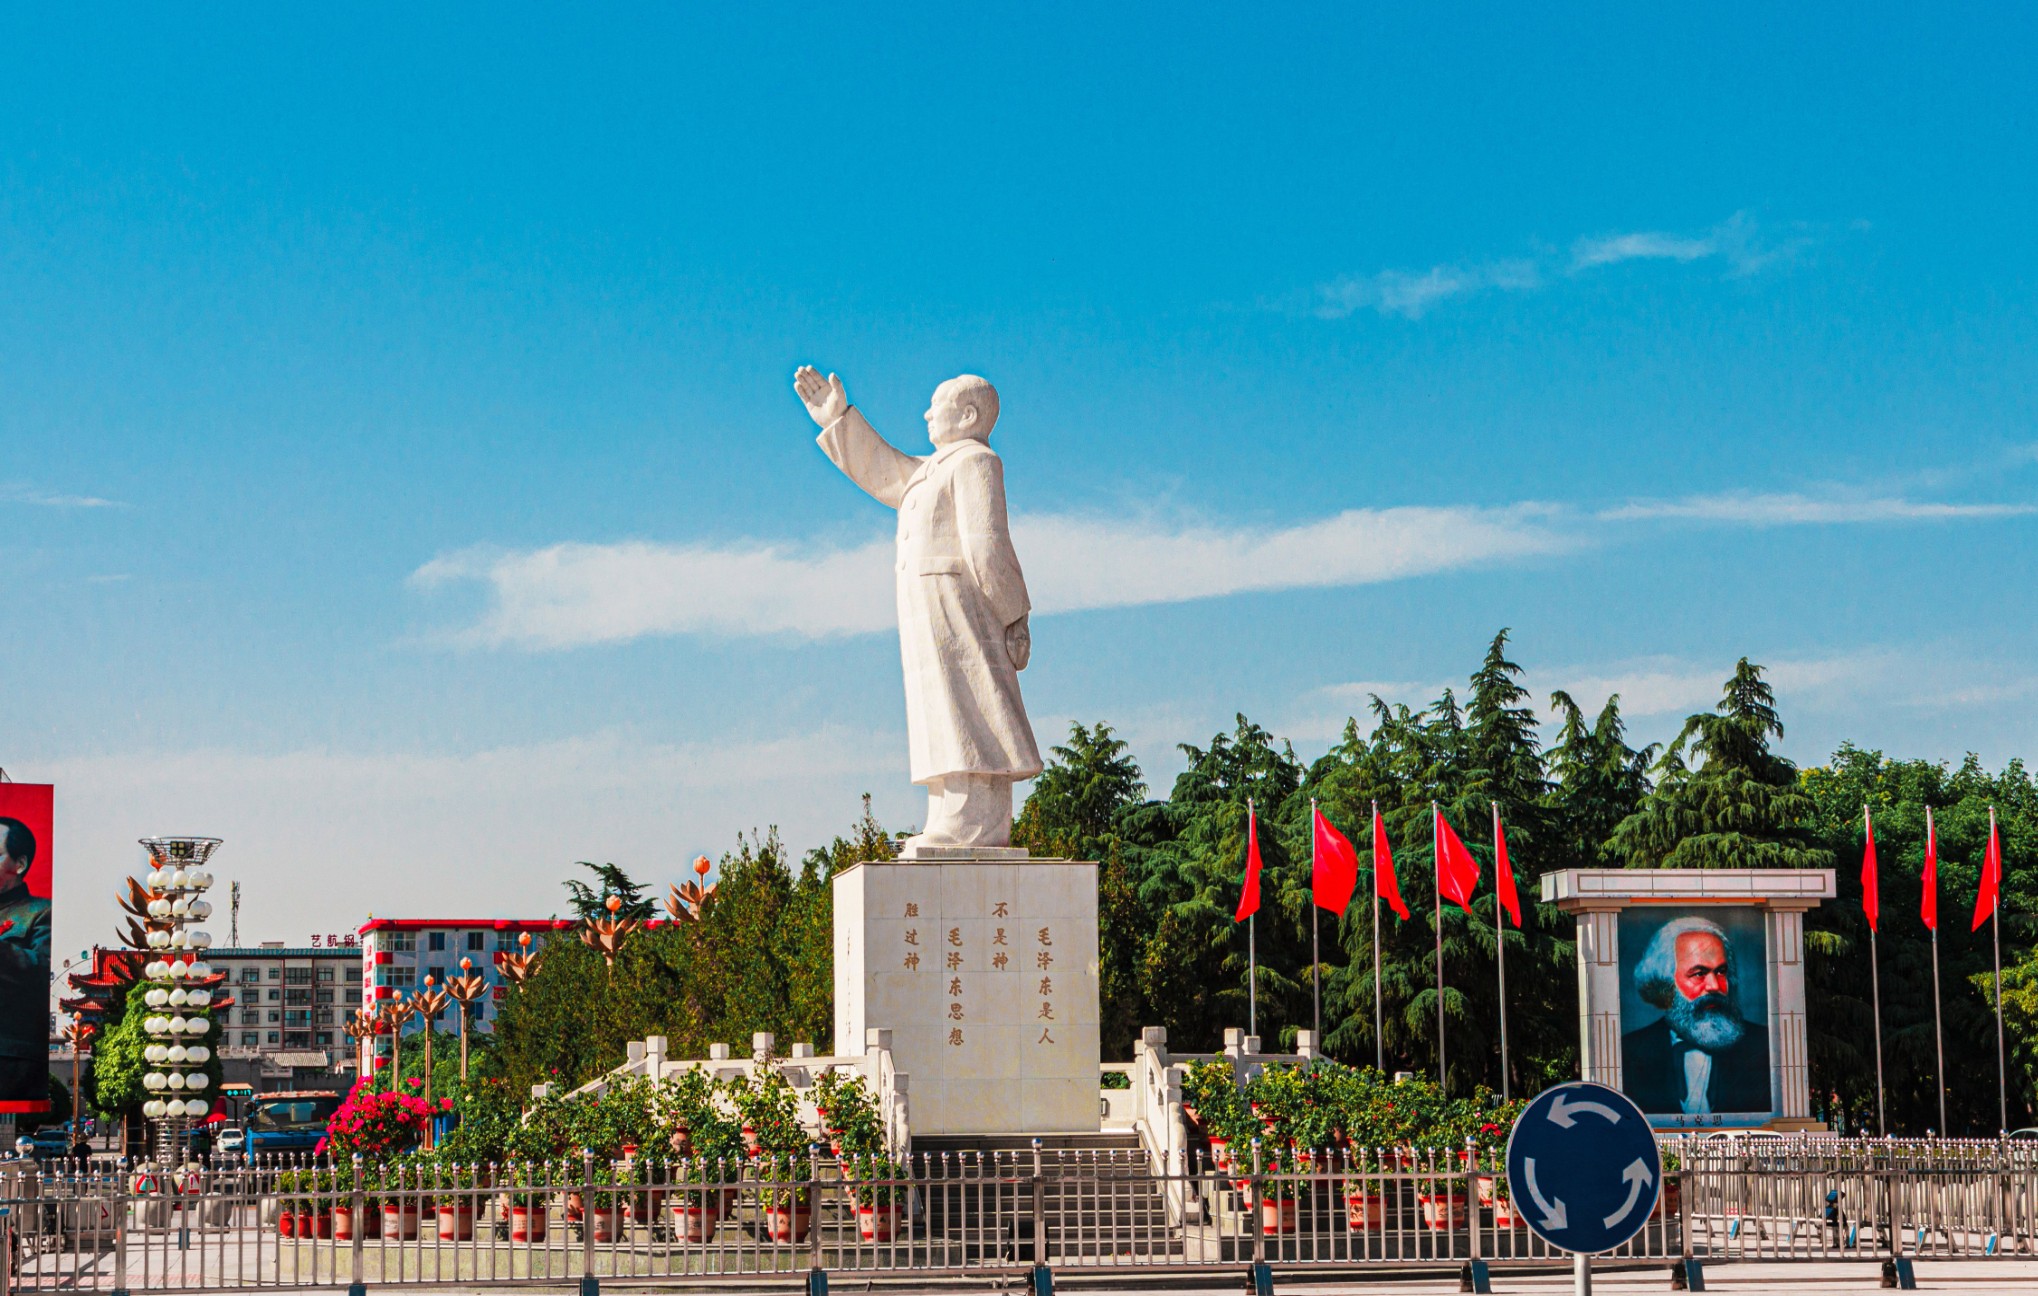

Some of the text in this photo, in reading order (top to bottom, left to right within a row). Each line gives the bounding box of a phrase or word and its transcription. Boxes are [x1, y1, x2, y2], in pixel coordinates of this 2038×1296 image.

[311, 934, 363, 947] 艺航钢
[904, 903, 920, 971] 胜过神
[992, 902, 1009, 971] 不是神
[947, 927, 964, 1046] 毛泽东思想
[1037, 927, 1055, 1045] 毛泽东是人
[1675, 1115, 1722, 1127] 马克思
